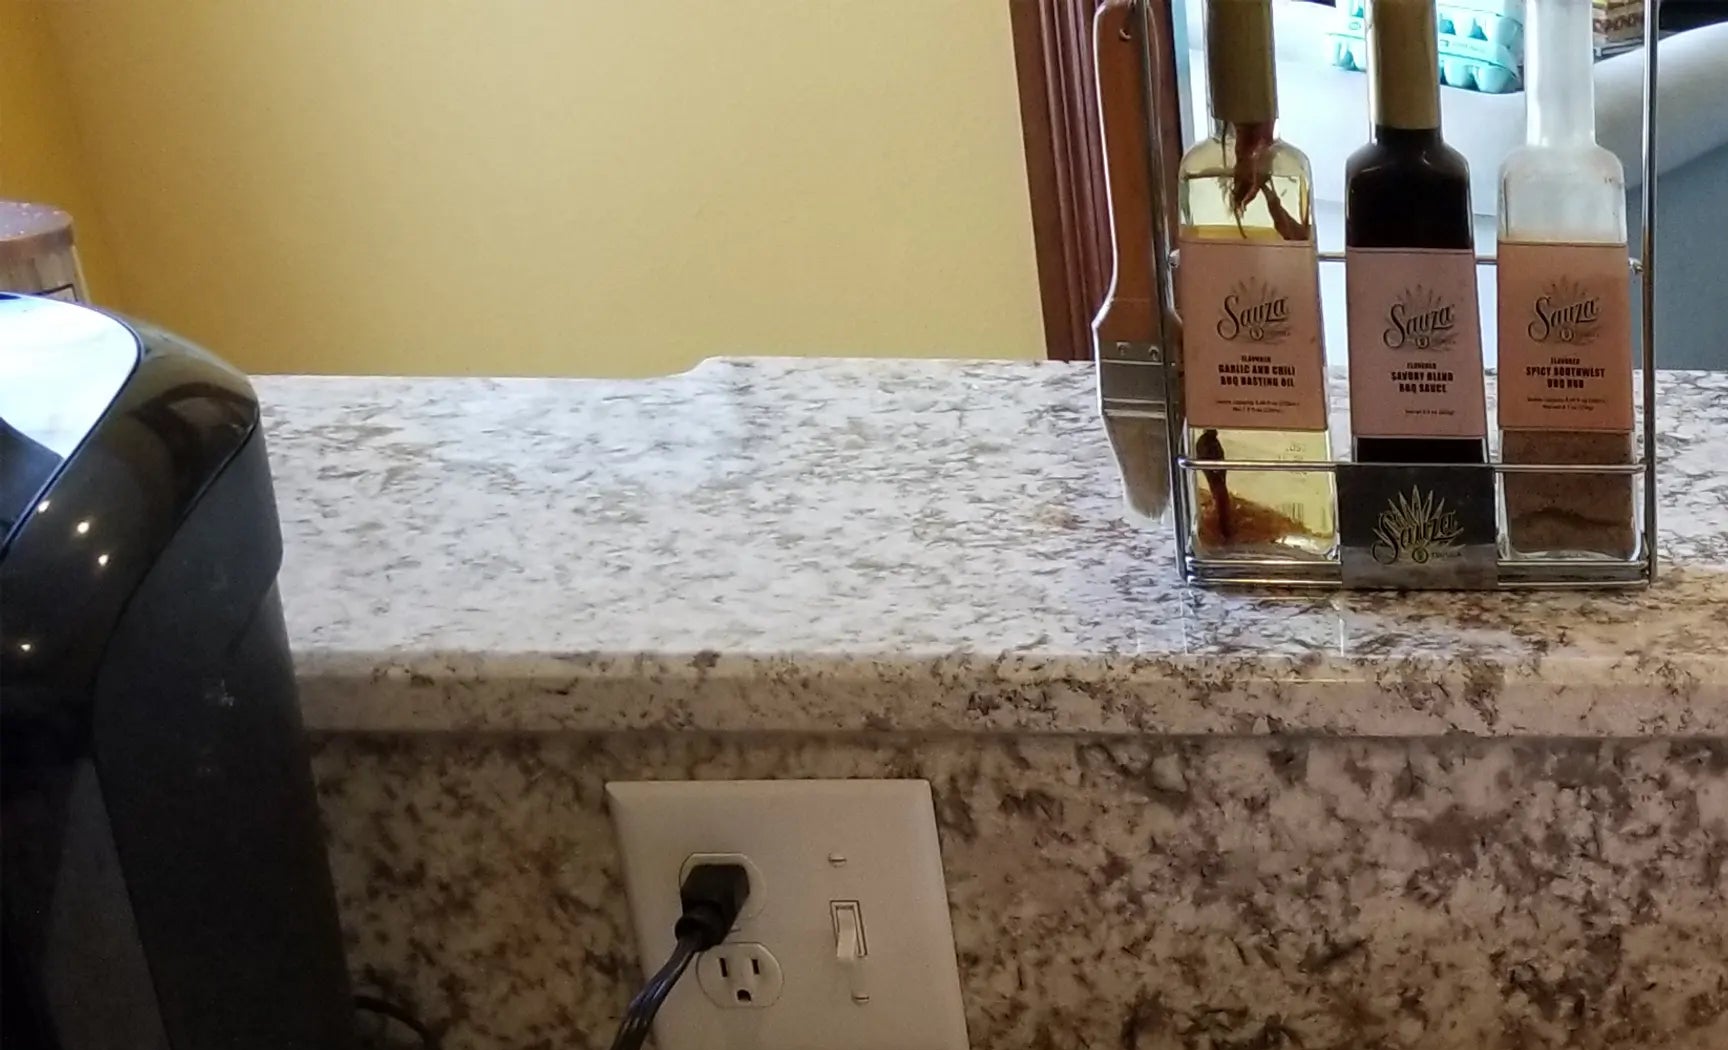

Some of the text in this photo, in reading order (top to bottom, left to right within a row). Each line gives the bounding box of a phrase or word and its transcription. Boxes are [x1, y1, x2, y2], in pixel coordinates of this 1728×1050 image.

[1217, 294, 1288, 341] Sauza
[1528, 296, 1600, 342] Sauza
[1383, 303, 1455, 349] Sauza
[1218, 364, 1250, 374] GARLIC
[1252, 365, 1270, 374] AND
[1526, 366, 1605, 378] SPICY SOUTHWEST
[1240, 376, 1279, 387] BASTING
[1281, 377, 1295, 388] OIL
[1391, 371, 1454, 381] SAVORY BLEND
[1399, 383, 1447, 394] BBQ SAUCE
[1372, 511, 1458, 565] Sauza
